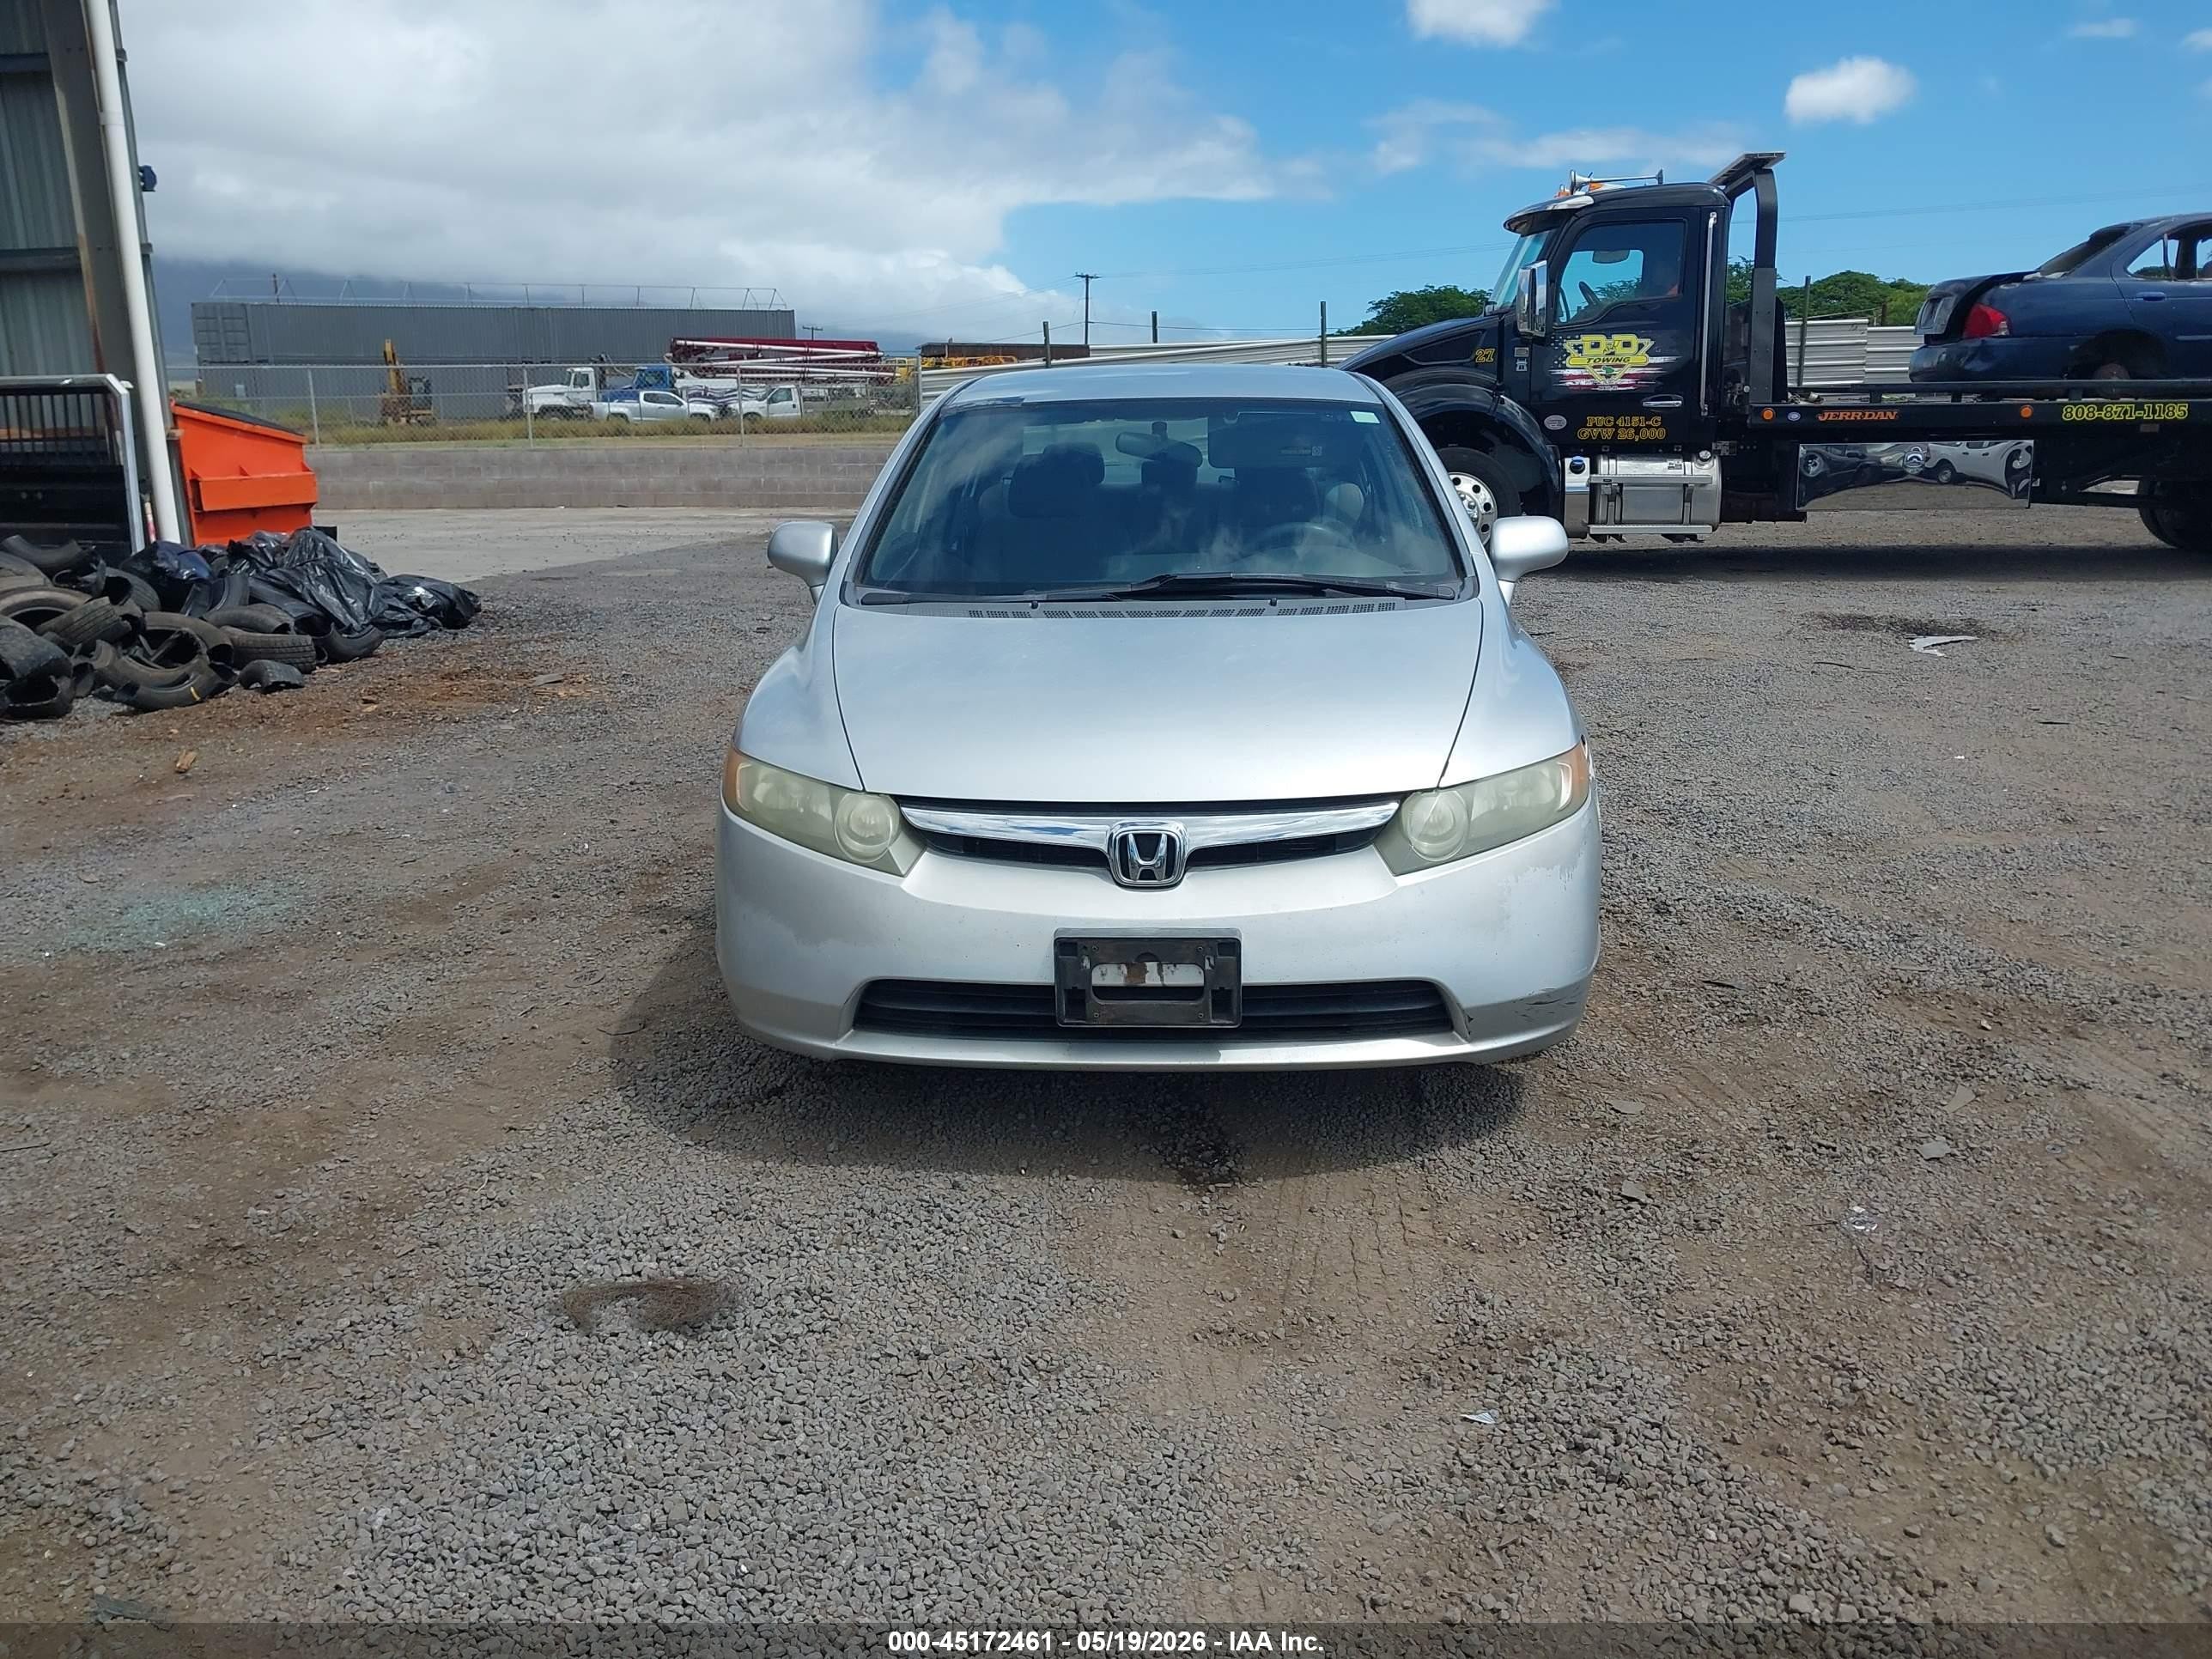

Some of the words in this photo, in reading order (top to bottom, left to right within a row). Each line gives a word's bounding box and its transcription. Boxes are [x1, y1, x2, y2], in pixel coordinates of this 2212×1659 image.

[1475, 348, 1496, 363] 27
[2062, 404, 2189, 421] 808-871-1185
[1586, 416, 1614, 427] PUC
[1577, 428, 1615, 440] GVW
[1617, 428, 1666, 441] 26,000
